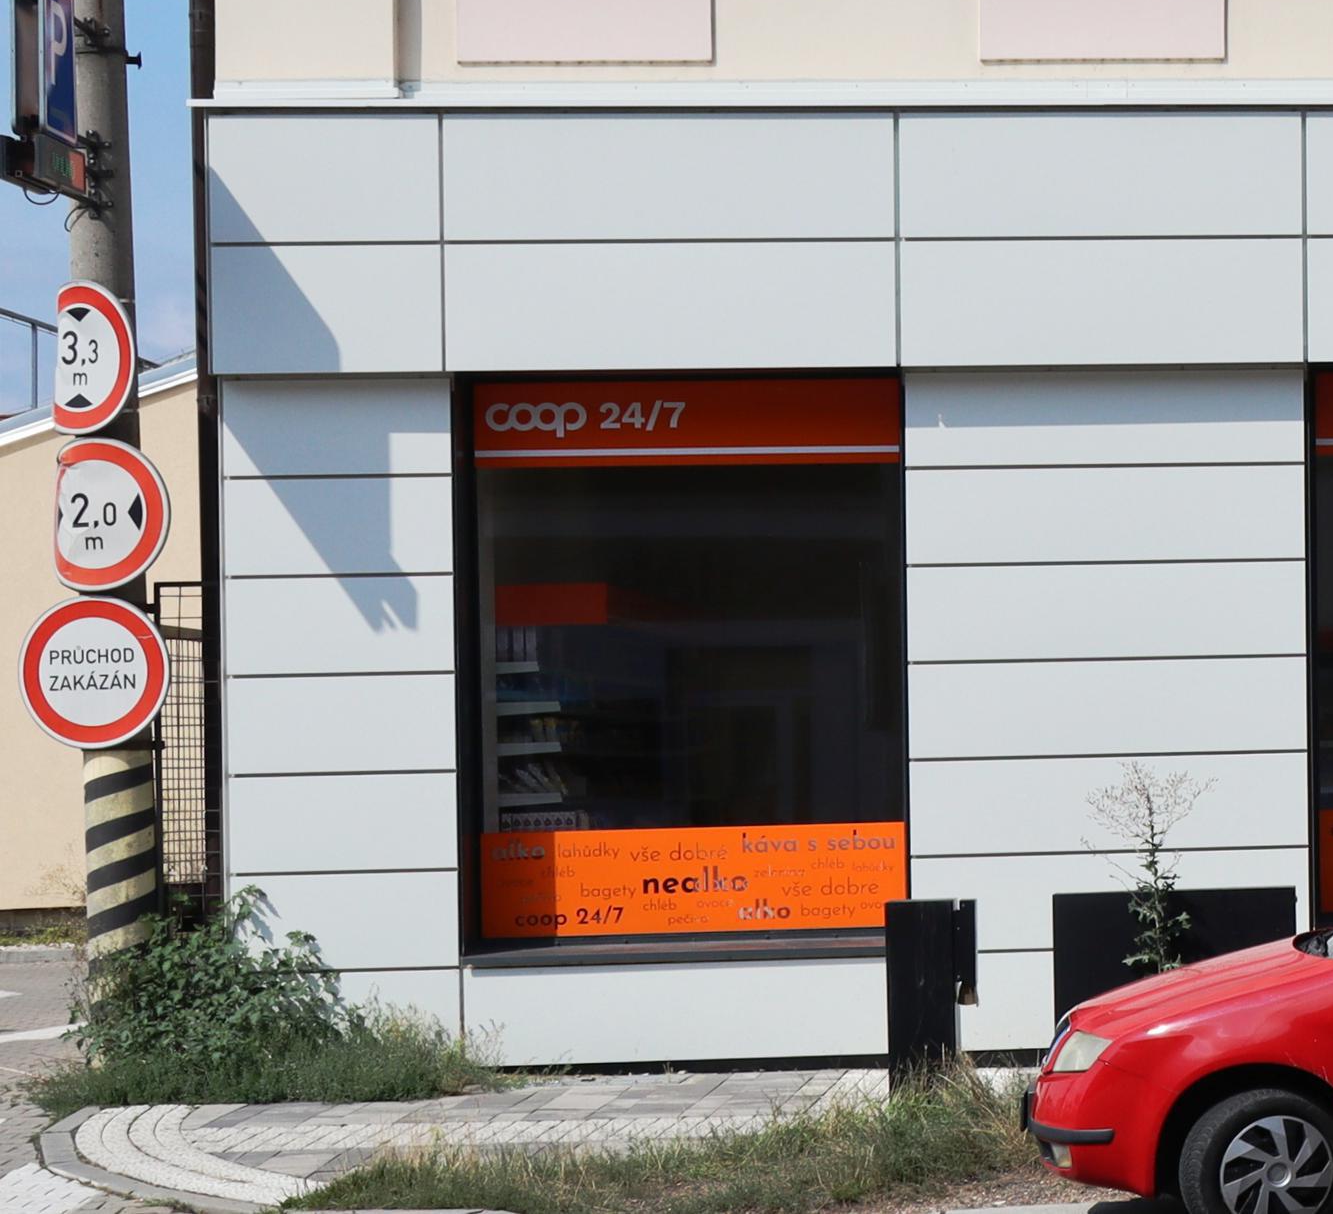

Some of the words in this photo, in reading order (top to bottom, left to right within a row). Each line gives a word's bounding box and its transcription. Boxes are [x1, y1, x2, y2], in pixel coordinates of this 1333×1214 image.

[61, 330, 99, 366] 3,3
[73, 372, 87, 386] m
[485, 402, 587, 437] coop
[600, 400, 686, 431] 24/7
[70, 492, 117, 529] 2,0
[85, 535, 104, 550] m
[49, 645, 134, 665] PRŮCHOD
[49, 670, 136, 691] ZAKÁZÁN
[557, 842, 621, 860] lahůdky
[742, 832, 799, 853] káva
[808, 838, 818, 852] s
[827, 829, 895, 851] sebou
[630, 846, 661, 862] vše
[669, 841, 728, 862] dobré
[643, 865, 749, 894] nealko
[782, 881, 812, 897] vše
[820, 877, 880, 896] dobré
[580, 883, 638, 901] bagety
[800, 903, 857, 920] bagety
[859, 901, 883, 911] ovo
[515, 912, 568, 930] coop
[576, 906, 624, 926] 24/7
